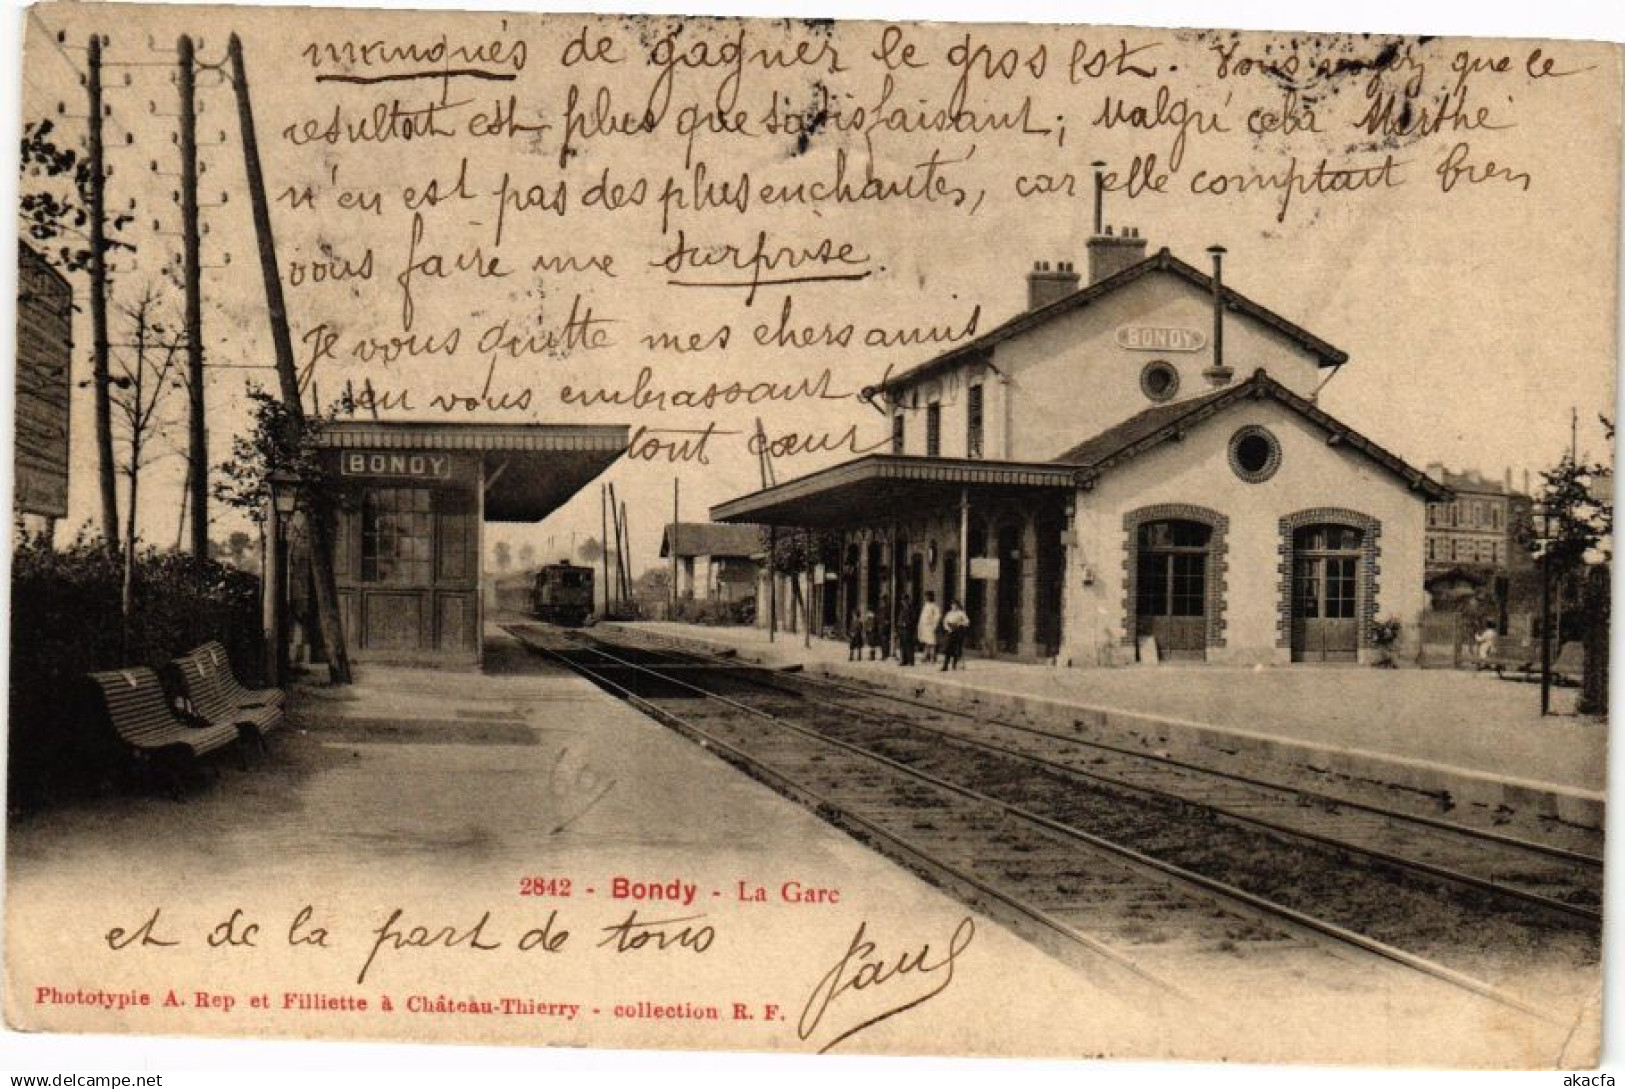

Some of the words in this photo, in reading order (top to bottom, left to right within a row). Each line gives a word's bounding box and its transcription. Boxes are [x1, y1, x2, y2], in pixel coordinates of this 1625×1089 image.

[562, 27, 623, 64] de
[649, 26, 851, 107] gagner
[872, 26, 930, 70] le
[948, 33, 1049, 110] gros
[1452, 50, 1514, 96] que
[1525, 50, 1598, 79] le
[469, 95, 553, 138] est
[559, 85, 656, 168] plus
[676, 105, 760, 169] que
[402, 158, 478, 206] est
[491, 172, 567, 247] pas
[582, 167, 647, 206] des
[658, 161, 750, 234] plus
[1014, 173, 1077, 198] car
[1102, 152, 1170, 199] elle
[1189, 155, 1407, 224] comptait
[1435, 142, 1532, 192] bien
[397, 212, 516, 332] faire
[531, 252, 615, 274] une
[298, 323, 340, 398] Je
[350, 326, 461, 366] vous
[640, 323, 733, 354] mes
[753, 295, 856, 348] chers
[863, 293, 983, 348] amis
[1127, 328, 1191, 348] BONDY
[429, 353, 534, 413] vous
[349, 454, 444, 474] BONDY
[519, 877, 572, 898] 2842
[611, 878, 698, 906] Bondy
[738, 880, 768, 902] La
[781, 881, 842, 904] Gare
[104, 907, 181, 951] et
[207, 907, 260, 947] de
[288, 904, 332, 948] la
[356, 907, 500, 985] part
[518, 909, 571, 952] de
[35, 986, 151, 1010] Phototypie
[163, 990, 185, 1008] A.
[194, 991, 236, 1013] Rep
[249, 995, 271, 1009] et
[282, 993, 368, 1012] Filliette
[381, 996, 394, 1013] à
[406, 994, 580, 1019] Château-Thierry
[613, 1001, 719, 1020] collection
[732, 1003, 754, 1020] R.
[764, 1004, 787, 1022] F.
